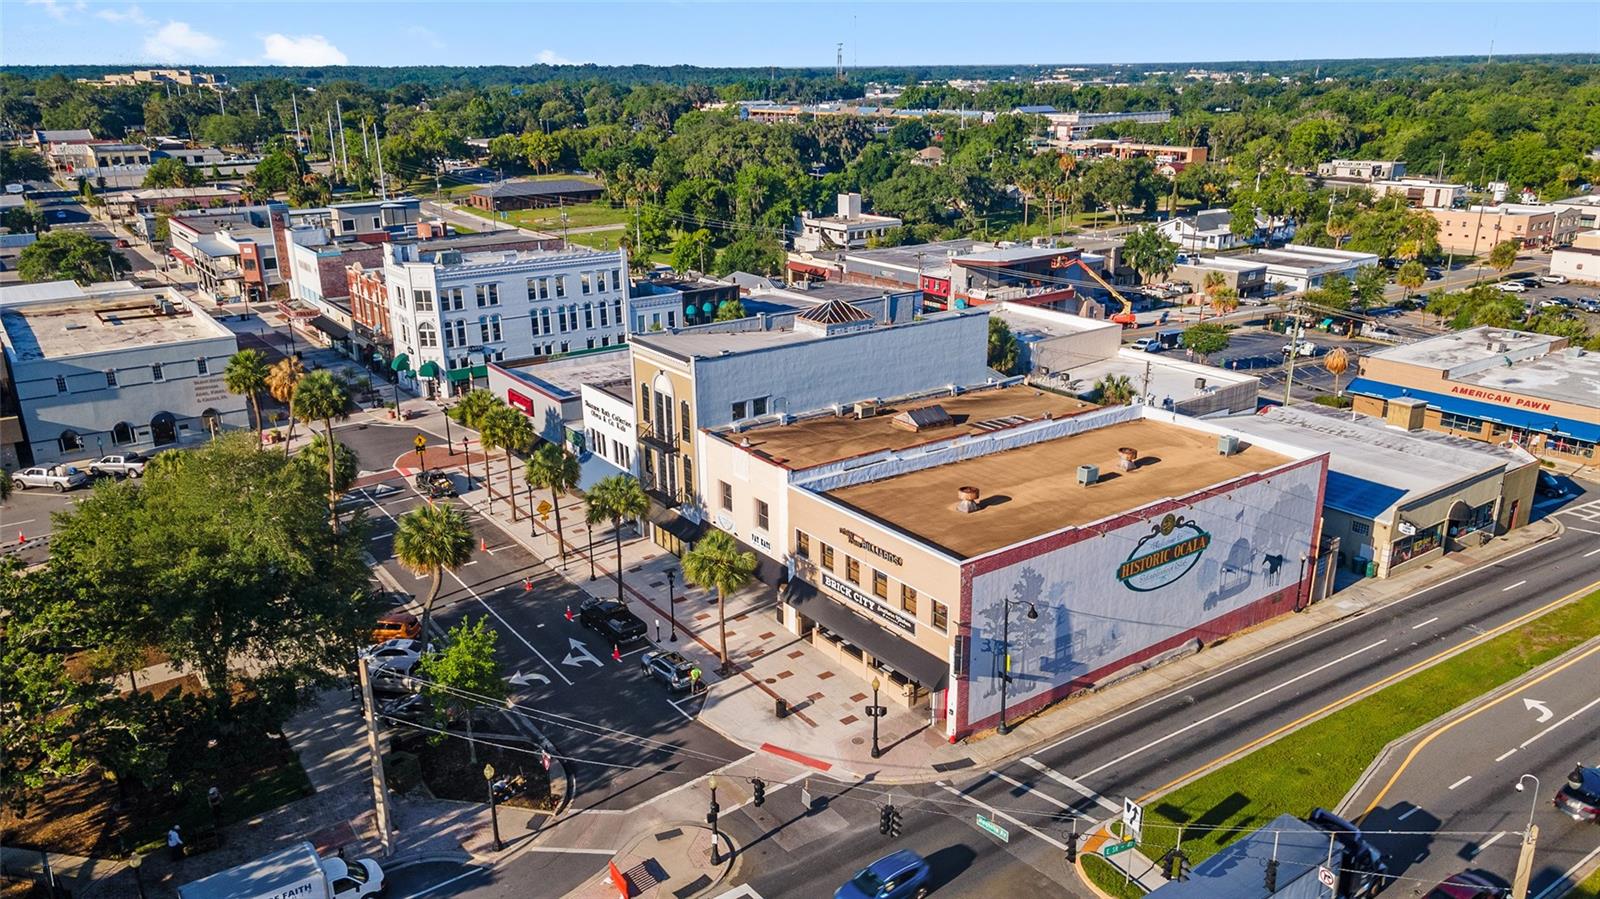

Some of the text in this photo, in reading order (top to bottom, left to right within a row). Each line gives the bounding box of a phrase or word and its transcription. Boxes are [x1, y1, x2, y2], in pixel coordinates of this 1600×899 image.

[1451, 386, 1551, 411] AMERICAN PAWN
[1121, 536, 1206, 578] HISTORIC OCALA
[825, 576, 875, 611] BRICK CITY
[282, 883, 312, 899] FAITH
